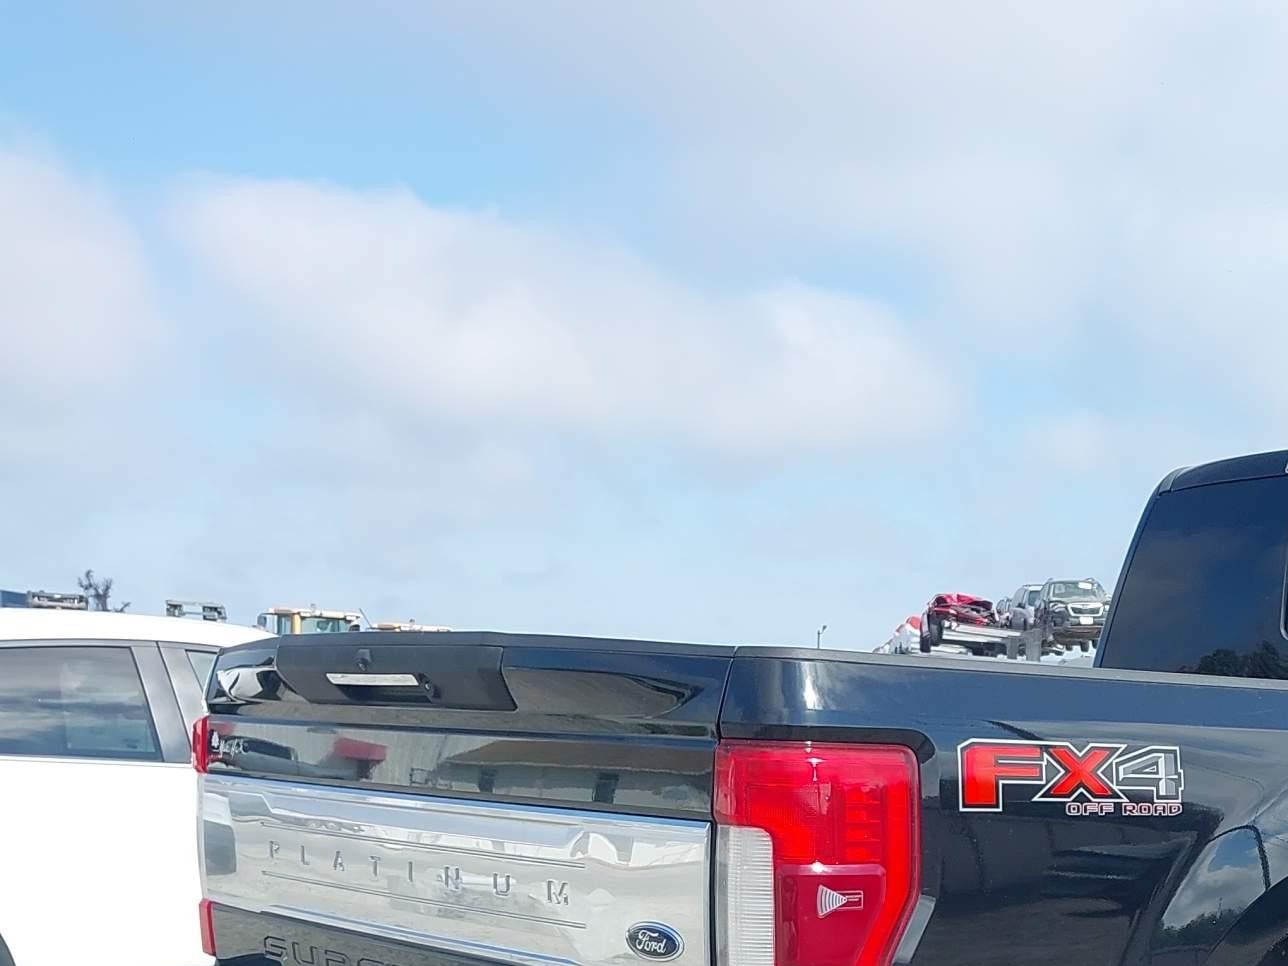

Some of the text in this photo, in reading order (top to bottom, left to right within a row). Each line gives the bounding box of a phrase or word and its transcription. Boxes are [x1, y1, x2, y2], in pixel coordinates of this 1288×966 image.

[957, 738, 1184, 812] FX4
[1066, 802, 1183, 817] OFF ROAD
[269, 840, 569, 905] PLATINUM
[635, 929, 668, 953] Ford
